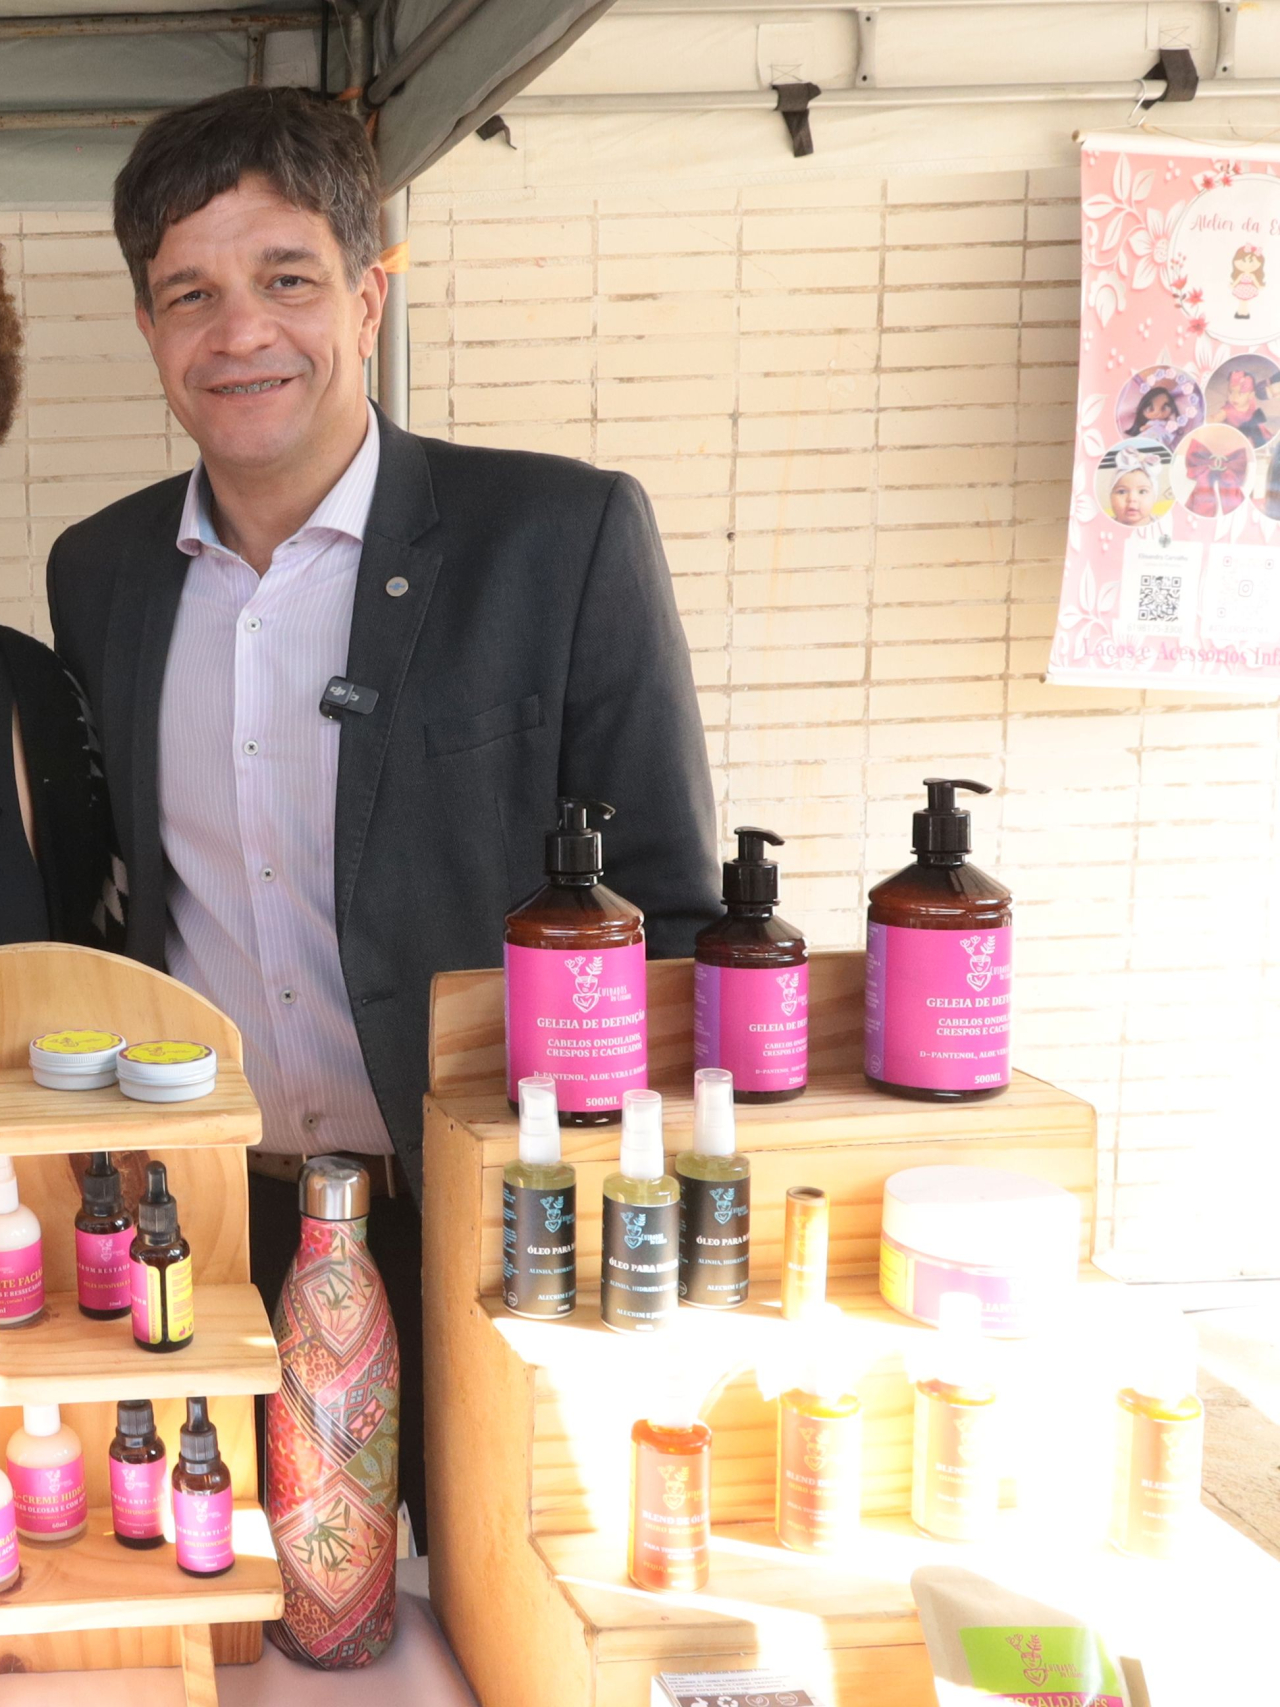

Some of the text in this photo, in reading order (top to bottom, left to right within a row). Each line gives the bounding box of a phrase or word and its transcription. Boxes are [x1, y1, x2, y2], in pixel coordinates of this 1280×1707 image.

[1190, 213, 1233, 232] Atelier
[1241, 217, 1260, 233] da
[1083, 637, 1135, 662] Laços
[1141, 646, 1151, 658] e
[926, 997, 972, 1008] GELEIA
[975, 996, 990, 1008] DE
[536, 1008, 646, 1029] GELEIA DE DEFINIÇÃO
[938, 1017, 983, 1027] CABELOS
[749, 1021, 796, 1033] GELEIA DE
[936, 1026, 988, 1037] CRESPOS E
[547, 1038, 591, 1048] CABELOS
[764, 1041, 793, 1050] CABELOS
[546, 1041, 643, 1058] CRESPOS E CACHEADOS
[762, 1049, 791, 1057] CRESPOS
[919, 1050, 978, 1062] D-PANTENOL,
[589, 1071, 610, 1081] ALOE
[611, 1069, 628, 1079] VERA
[974, 1072, 1002, 1085] 500ML
[585, 1096, 619, 1107] 500ML
[696, 1234, 742, 1247] ÓLEO PARA
[527, 1244, 570, 1256] ÓLEO PARA
[608, 1256, 656, 1273] ÓLEO PARA
[786, 1469, 815, 1486] BLEND
[642, 1510, 675, 1525] BLEND
[52, 1520, 68, 1529] 60ml
